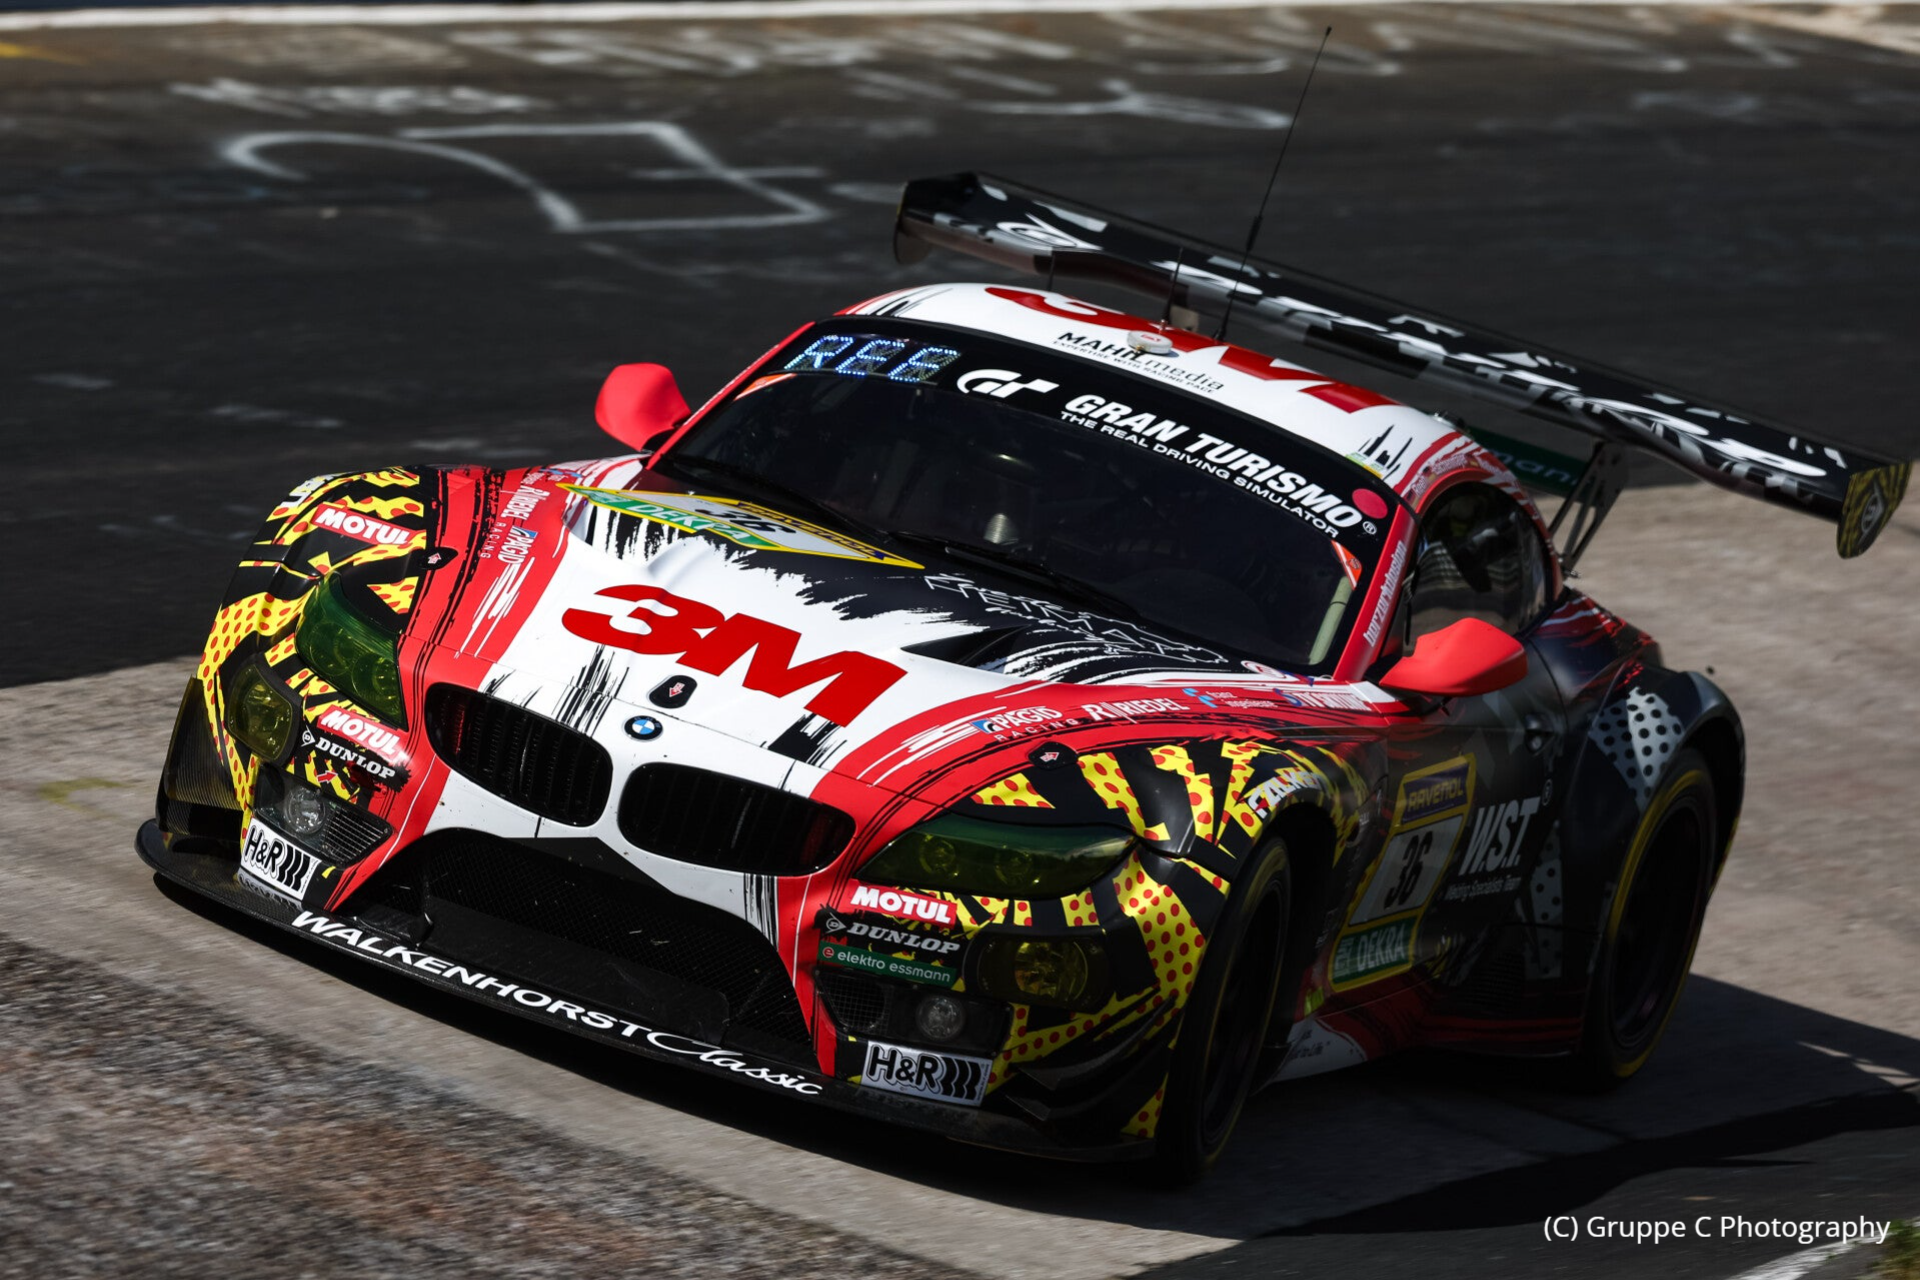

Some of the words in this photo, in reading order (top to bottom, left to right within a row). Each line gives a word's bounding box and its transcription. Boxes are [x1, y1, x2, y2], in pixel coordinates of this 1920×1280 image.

[1186, 381, 1216, 394] PACE
[1059, 411, 1095, 431] THE
[1099, 420, 1150, 448] REAL
[1152, 439, 1231, 479] DRIVING
[1233, 476, 1340, 539] SIMULATOR
[1064, 394, 1190, 445] GRAN
[1186, 433, 1365, 529] TURISMO
[314, 508, 410, 545] MOTUL
[630, 503, 753, 541] DEKRA
[695, 507, 797, 534] 36
[479, 522, 506, 559] RACING
[497, 532, 534, 564] PAGID
[562, 584, 909, 728] 3M
[320, 709, 400, 752] MOTUL
[994, 718, 1080, 742] RACING
[996, 705, 1063, 730] PAGID
[315, 736, 396, 780] DUNLOP
[1407, 776, 1464, 812] RAVENOL
[244, 824, 284, 874] H&R
[1384, 831, 1434, 910] 36
[851, 886, 952, 924] MOTUL
[847, 922, 961, 954] DUNLOP
[1356, 923, 1407, 973] DEKRA
[837, 950, 886, 970] elektro
[889, 962, 951, 983] essmann
[291, 911, 652, 1037] WALKENHORST
[647, 1032, 823, 1095] Classic
[867, 1046, 940, 1090] H&R
